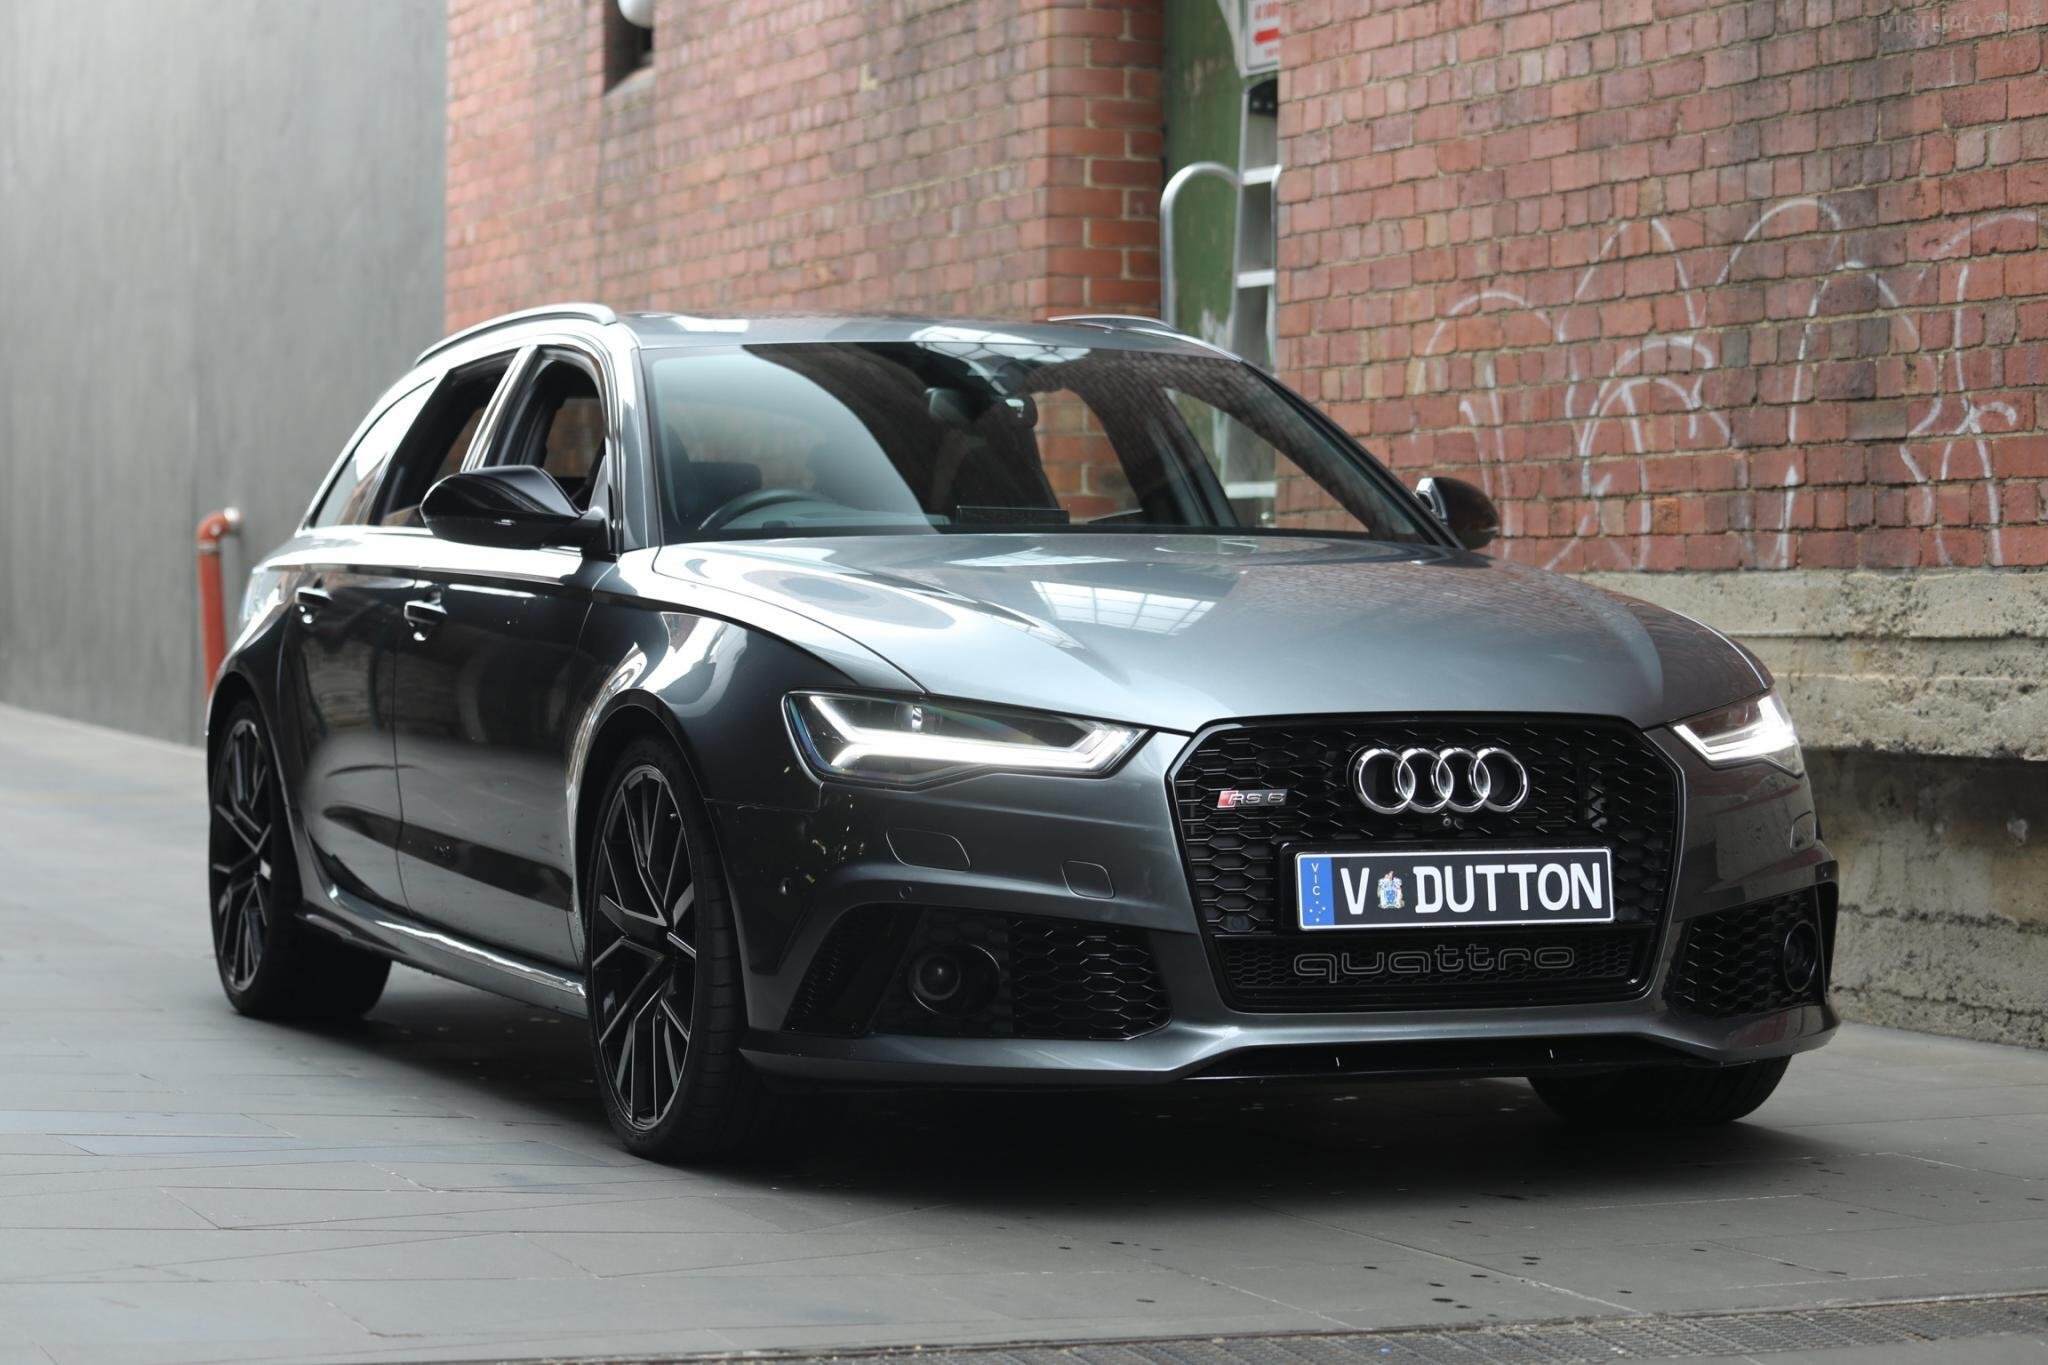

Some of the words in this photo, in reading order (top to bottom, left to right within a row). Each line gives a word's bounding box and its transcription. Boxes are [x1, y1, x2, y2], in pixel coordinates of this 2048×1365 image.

[1227, 793, 1263, 805] RS
[1311, 863, 1321, 896] VIC
[1340, 867, 1370, 915] V
[1412, 862, 1603, 914] DUTTON
[1293, 944, 1575, 984] quattro
